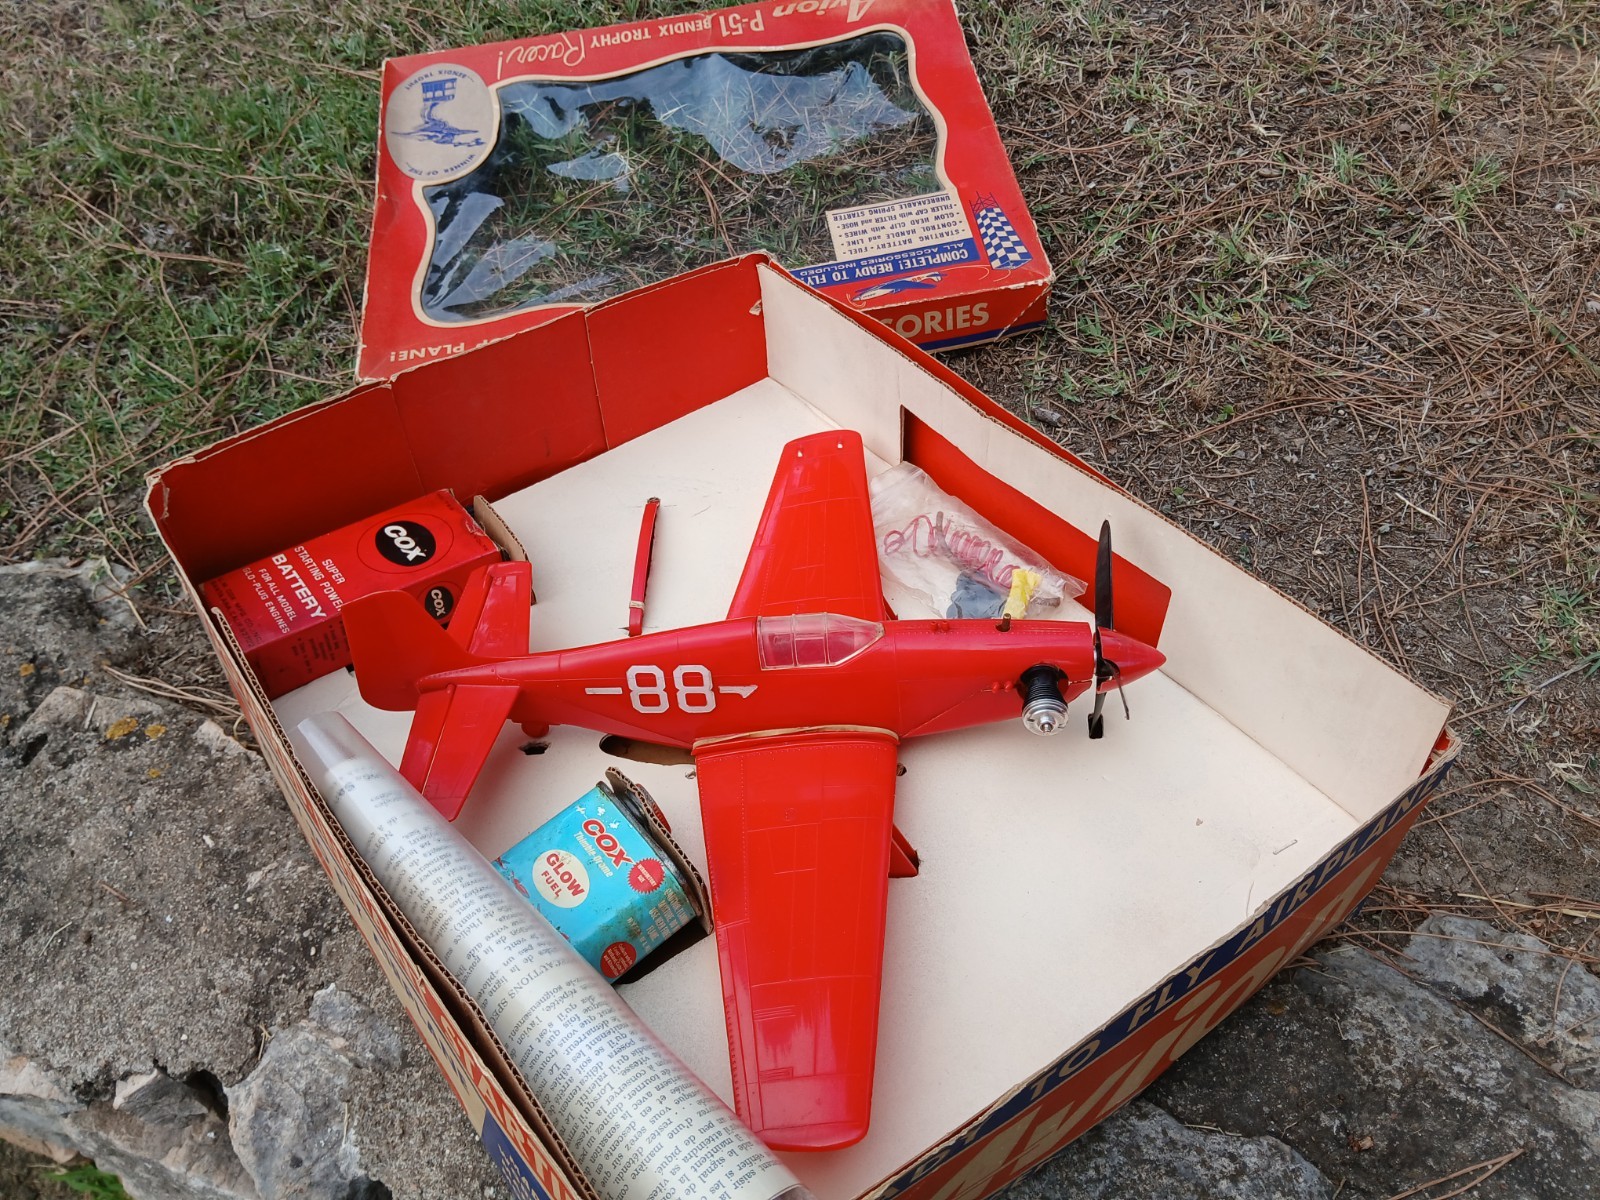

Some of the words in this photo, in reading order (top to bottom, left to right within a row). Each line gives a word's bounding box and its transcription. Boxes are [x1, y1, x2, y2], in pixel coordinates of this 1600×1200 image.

[658, 16, 712, 36] BENDIX
[718, 9, 764, 36] P-51
[590, 27, 650, 47] TROPHY
[868, 205, 895, 215] SPRING
[898, 195, 950, 210] UNBREAKABLE
[930, 203, 952, 212] FILLER
[833, 211, 864, 221] STARTER
[860, 218, 872, 226] and
[874, 214, 896, 223] FILTER
[899, 210, 912, 219] with
[910, 216, 928, 225] HEAD
[933, 212, 954, 220] GLOW
[841, 221, 858, 229] HOSE
[844, 228, 867, 237] WIRES
[870, 225, 885, 233] with
[885, 228, 916, 239] HANDLE
[889, 221, 905, 229] CLIP
[920, 220, 956, 231] CONTROL
[845, 238, 863, 246] LINE
[876, 238, 912, 250] BATTERY
[918, 229, 959, 241] STARTING
[847, 246, 867, 254] FUEL
[943, 242, 964, 250] ALL
[859, 247, 938, 265] ACCESSORIES
[898, 248, 968, 270] COMPLETE!
[799, 262, 855, 275] INCLUDED
[831, 270, 849, 281] TO
[854, 262, 892, 278] READY
[390, 342, 465, 362] PLANE!
[384, 525, 426, 561] COX
[293, 544, 324, 581] STARTING
[321, 557, 345, 584] SUPER
[258, 567, 272, 582] FOR
[267, 580, 281, 595] ALL
[275, 594, 297, 621] MODEL
[271, 551, 326, 619] BATTERY
[242, 566, 269, 600] GLO-PLUG
[264, 600, 290, 633] ENGINES
[431, 589, 446, 617] COX
[626, 664, 716, 714] 88
[582, 818, 634, 868] COX
[541, 870, 563, 896] FUEL
[546, 853, 584, 896] GLOW
[1028, 1039, 1102, 1100] TO
[1127, 954, 1218, 1033] FLY
[1237, 766, 1449, 955] AIRPLANE
[488, 976, 508, 997] ligne
[508, 984, 563, 1042] soigneusement
[557, 1003, 578, 1022] qu'il
[562, 1014, 581, 1028] fois
[580, 1015, 596, 1028] que
[516, 1016, 542, 1045] l'avion
[535, 1022, 554, 1043] s'est
[545, 1030, 560, 1047] que
[558, 1029, 578, 1048] vous
[563, 1019, 609, 1056] démarreur.
[607, 1032, 627, 1049] qu'il
[607, 1038, 636, 1059] posera
[529, 1050, 544, 1070] vous
[572, 1049, 586, 1063] les
[594, 1046, 605, 1056] se
[532, 1048, 558, 1084] trouviez
[548, 1062, 561, 1076] Le
[576, 1056, 592, 1074] soit
[608, 1054, 630, 1074] qu'il
[618, 1056, 650, 1076] vitesse.
[550, 1064, 571, 1092] câbles
[606, 1069, 646, 1106] conserver
[624, 1074, 660, 1100] tourner,
[554, 1076, 574, 1105] arrêté
[575, 1072, 608, 1107] ralentit.
[578, 1082, 614, 1125] Lorsqu'il
[632, 1091, 653, 1110] avec
[657, 1095, 666, 1105] et
[595, 1106, 607, 1116] la
[595, 1102, 623, 1135] donnez
[620, 1110, 633, 1120] la
[640, 1106, 652, 1117] en
[649, 1106, 672, 1125] vous
[574, 1121, 594, 1150] vitesse
[646, 1118, 673, 1144] restez
[667, 1117, 693, 1139] d'une
[698, 1120, 715, 1134] peu
[586, 1136, 596, 1148] un
[589, 1122, 620, 1164] sensation
[604, 1121, 636, 1160] descente
[624, 1126, 646, 1151] serez
[682, 1130, 723, 1163] atteindra
[683, 1134, 698, 1148] de
[612, 1153, 624, 1170] sûr
[630, 1142, 664, 1180] manière
[654, 1145, 682, 1176] piqué.
[690, 1137, 734, 1172] maintient
[727, 1148, 738, 1157] le
[613, 1146, 643, 1184] détendu.
[670, 1164, 680, 1176] sa
[698, 1156, 726, 1183] signal
[600, 1170, 612, 1188] que
[678, 1173, 690, 1184] la
[725, 1170, 734, 1181] si
[732, 1169, 756, 1190] saisir
[684, 1183, 696, 1196] de
[709, 1180, 725, 1194] les
